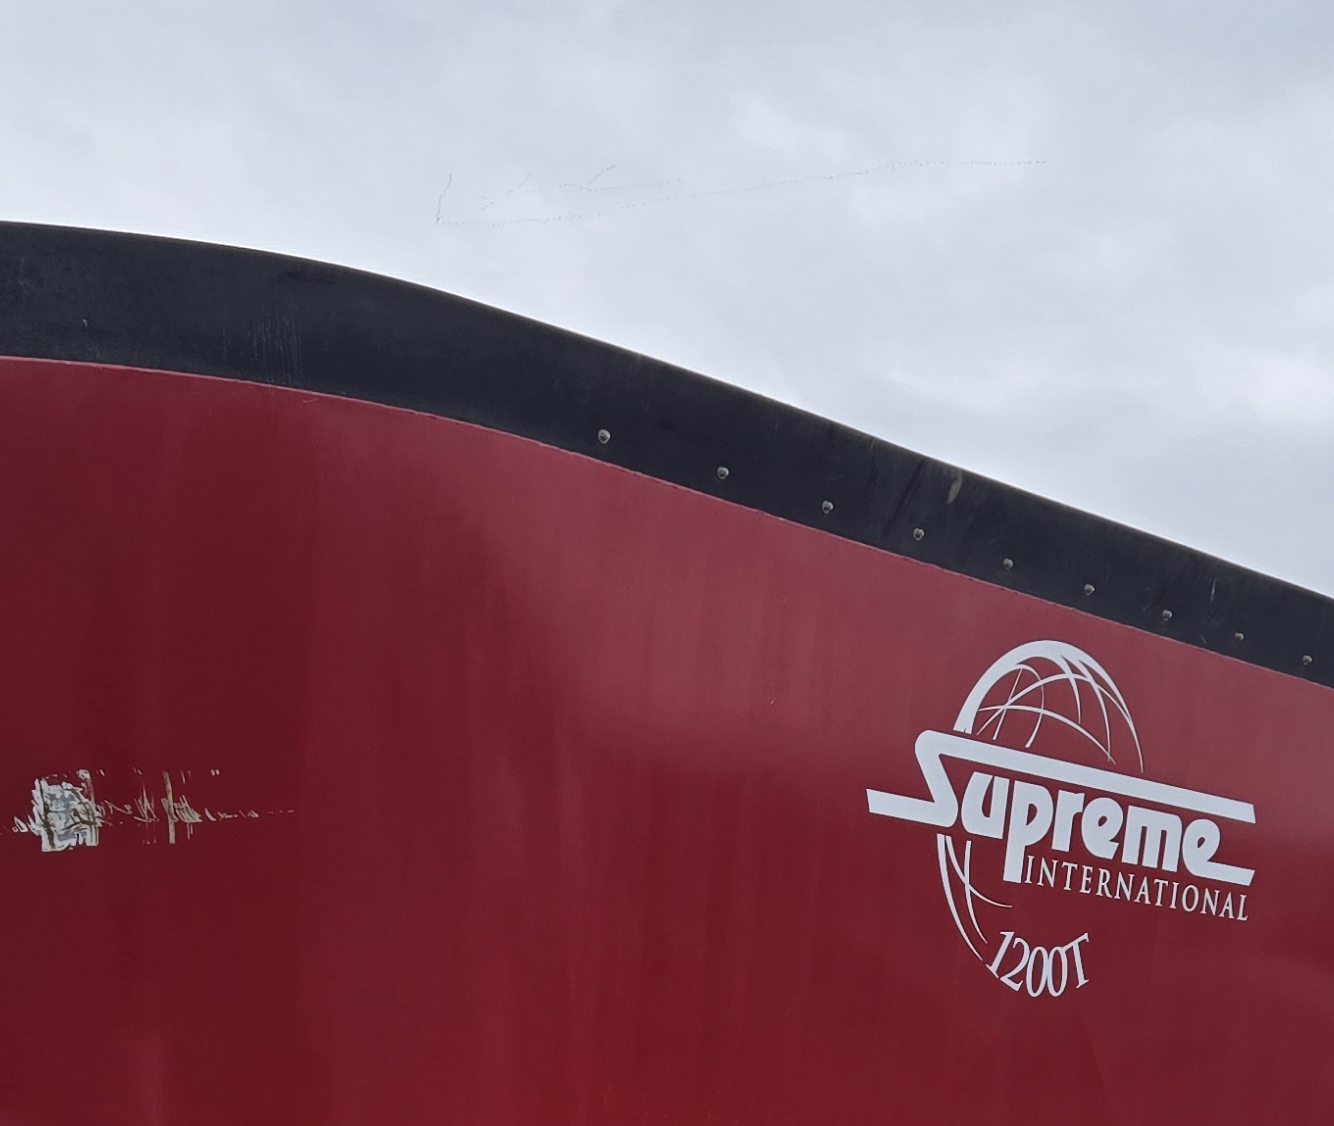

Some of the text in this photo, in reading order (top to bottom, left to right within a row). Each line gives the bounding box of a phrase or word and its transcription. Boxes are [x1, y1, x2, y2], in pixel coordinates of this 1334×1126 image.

[866, 730, 1256, 886] Supreme
[1023, 855, 1249, 921] INTERNATIONAL
[985, 931, 1089, 998] 1200T
